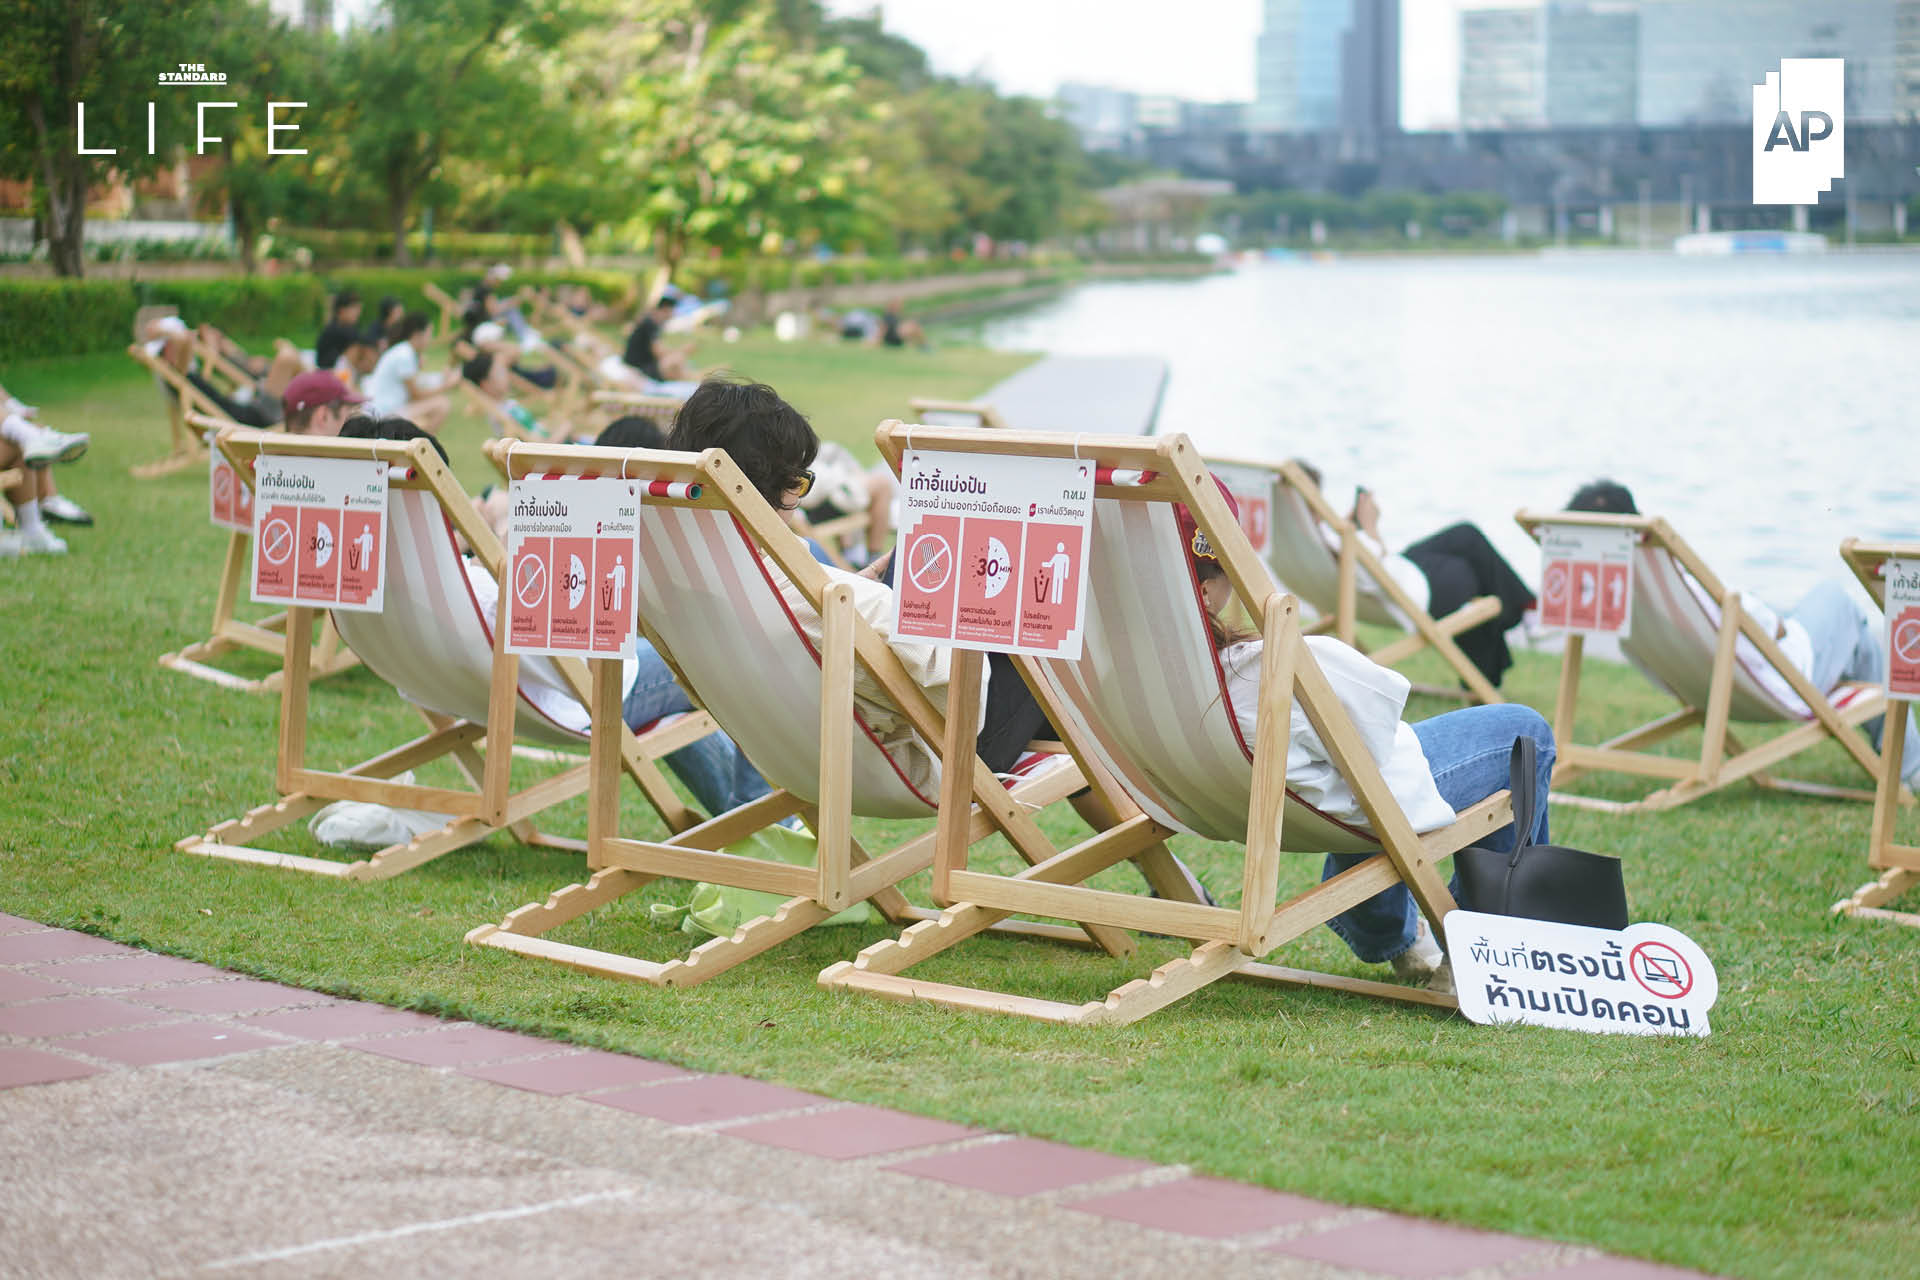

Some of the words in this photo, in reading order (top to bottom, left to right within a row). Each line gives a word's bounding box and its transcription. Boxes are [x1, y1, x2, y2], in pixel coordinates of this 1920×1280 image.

[262, 470, 315, 489] เก้าอี้แบ่งปัน
[909, 468, 987, 494] เก้าอี้แบ่งปัน
[514, 496, 568, 517] เก้าอี้แบ่งปัน
[908, 496, 940, 508] วิวตรงนี้
[941, 499, 1022, 515] น่ามองกว่ามือถือเยอะ
[310, 536, 325, 551] 30
[976, 557, 999, 577] 30
[999, 565, 1013, 574] MIN
[562, 573, 578, 590] 30
[1893, 571, 1920, 590] เก้าอี้
[1470, 936, 1626, 982] พื้นที่ตรงนี้
[1485, 974, 1690, 1029] ห้ามเปิดคอม
